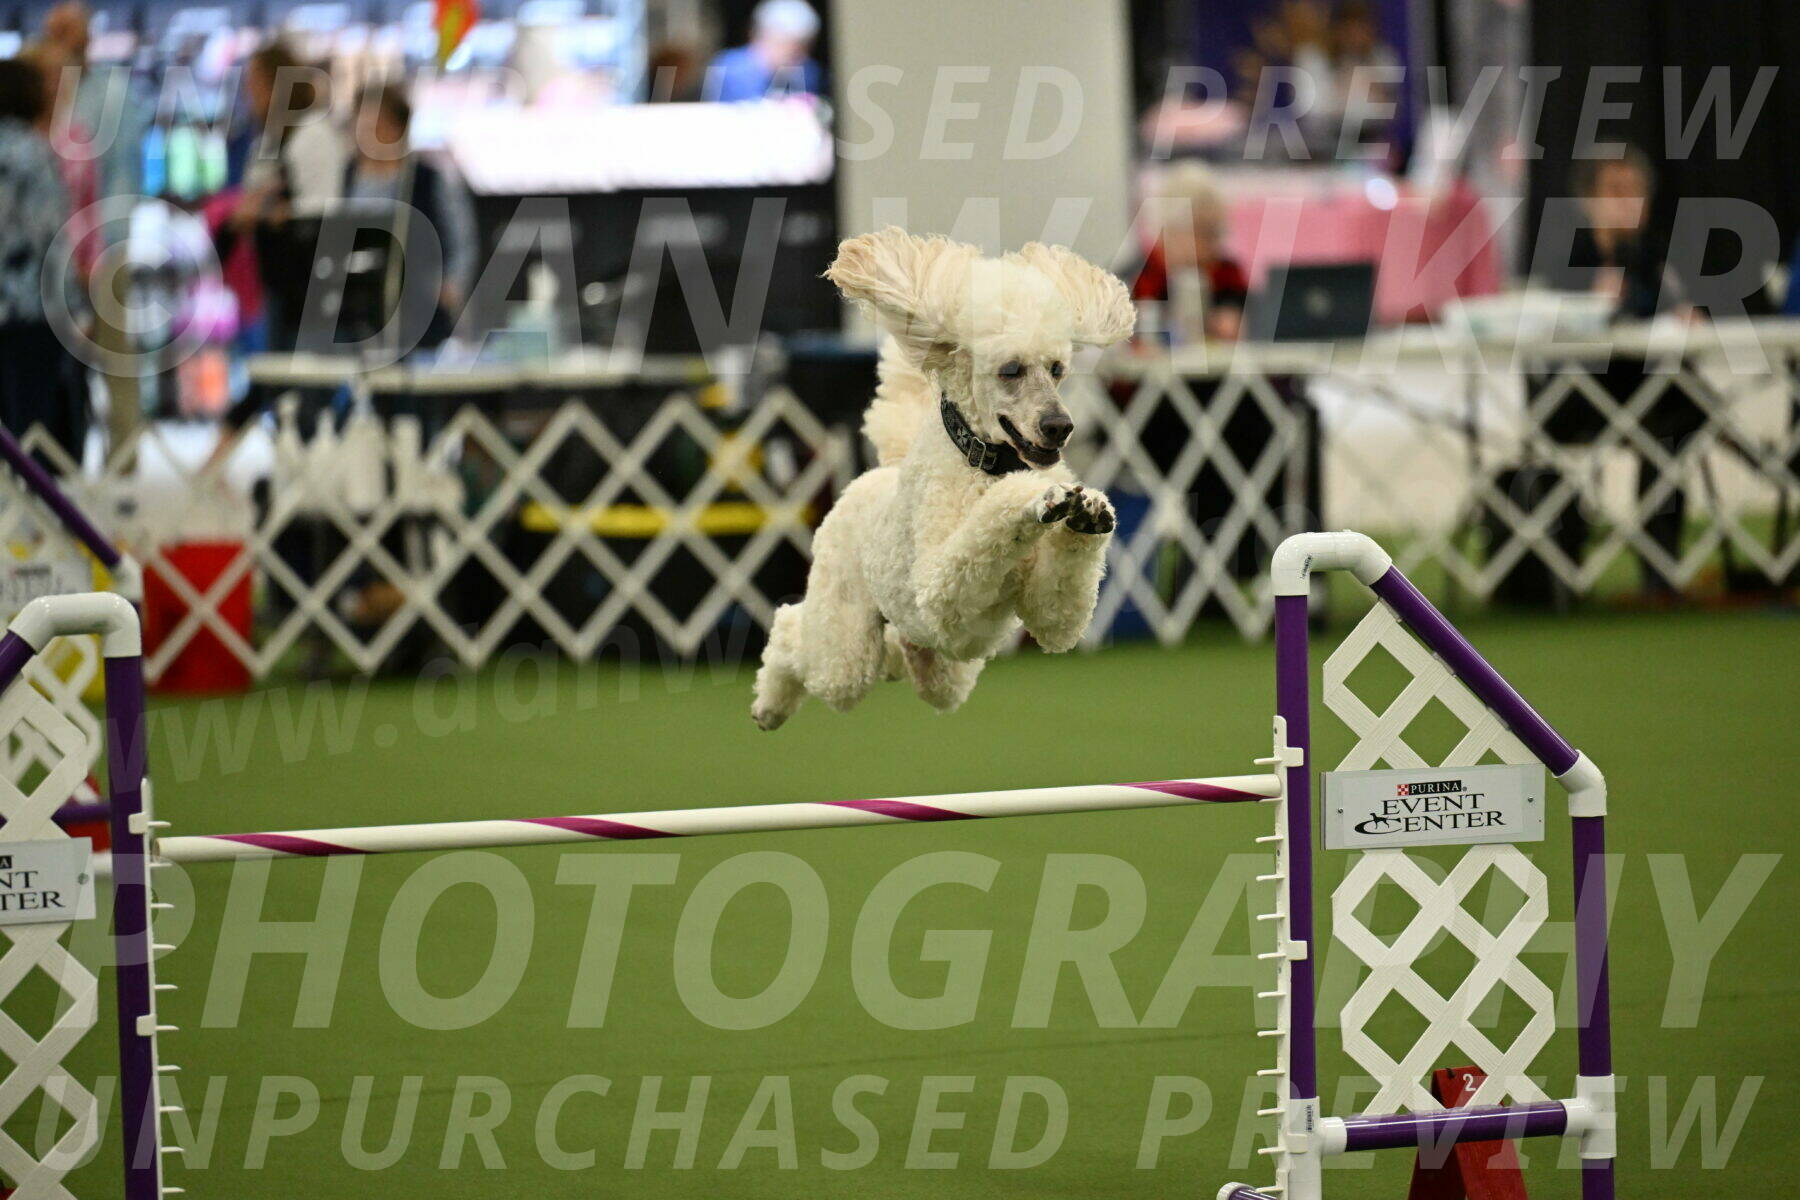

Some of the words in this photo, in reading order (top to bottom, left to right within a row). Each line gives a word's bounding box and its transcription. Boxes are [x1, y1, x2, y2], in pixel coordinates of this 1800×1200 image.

[1411, 783, 1460, 793] PURINA
[1383, 794, 1484, 815] EVENT
[1354, 810, 1507, 835] CENTER
[1463, 1073, 1477, 1092] 2
